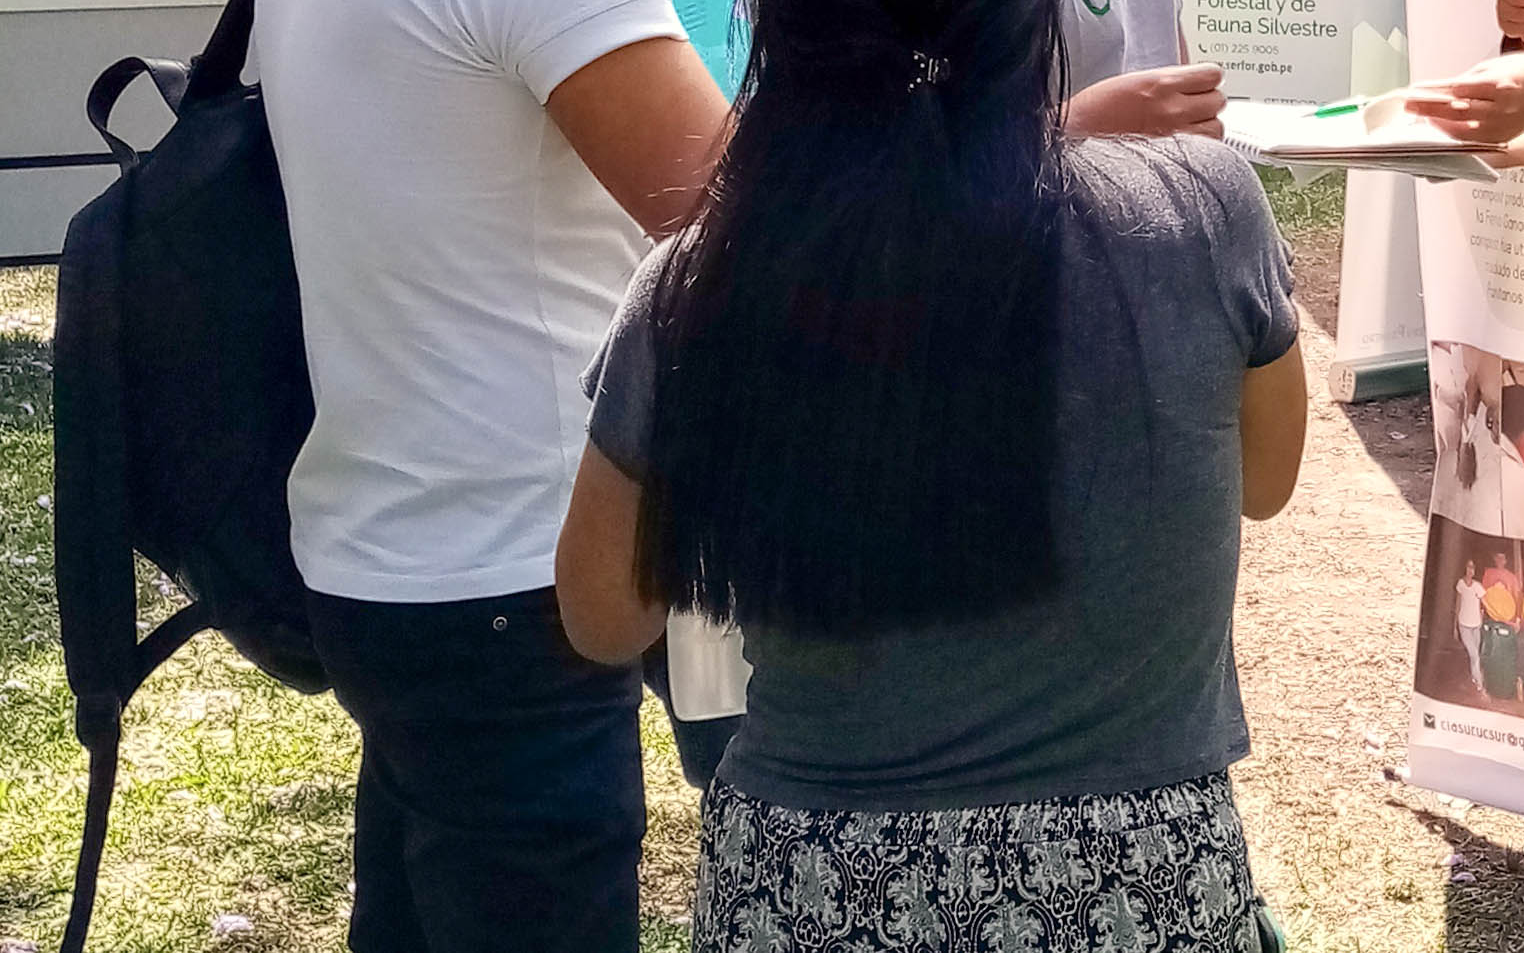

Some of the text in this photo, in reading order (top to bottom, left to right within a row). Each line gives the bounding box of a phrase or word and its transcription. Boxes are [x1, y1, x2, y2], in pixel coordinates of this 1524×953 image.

[1197, 15, 1338, 38] Fauna Silvestre
[1231, 43, 1250, 54] 225
